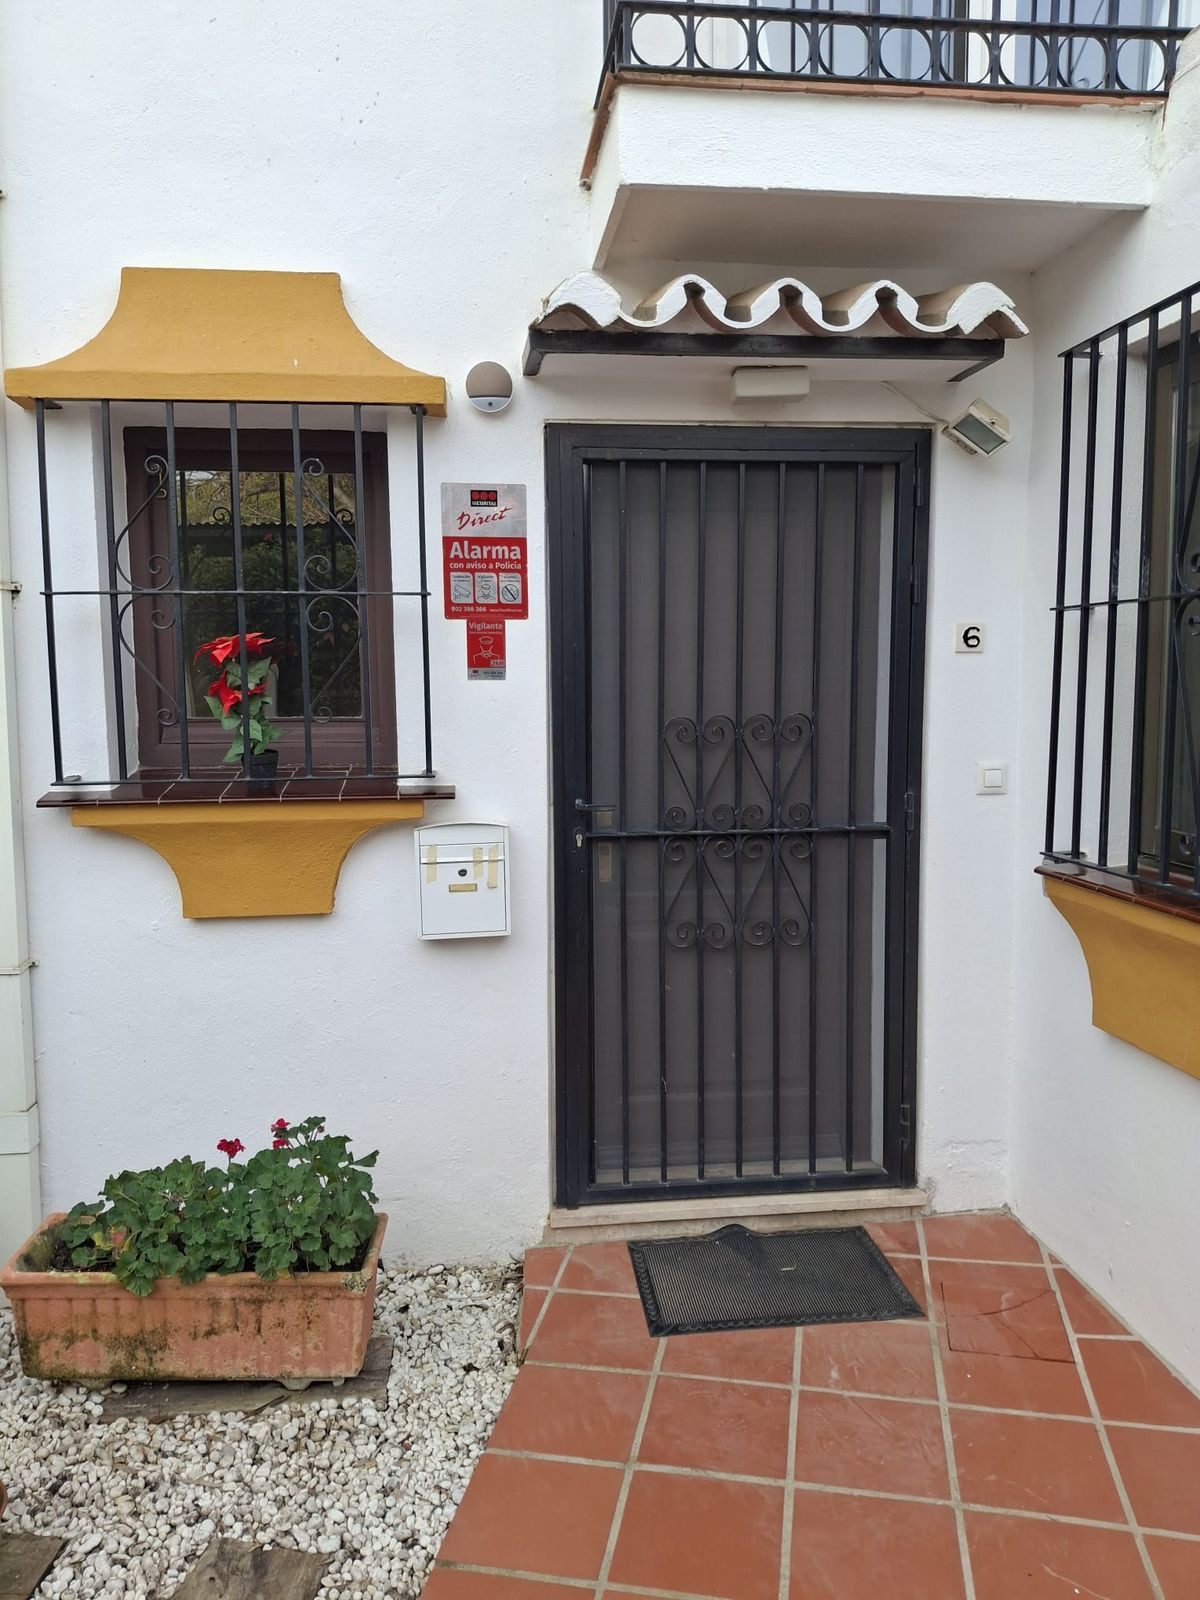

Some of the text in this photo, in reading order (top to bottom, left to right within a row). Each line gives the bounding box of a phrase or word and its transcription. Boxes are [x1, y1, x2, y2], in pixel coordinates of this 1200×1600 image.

[457, 507, 512, 530] Direct
[450, 541, 521, 559] Alarma
[465, 560, 487, 569] aviso
[495, 561, 521, 569] Policía
[468, 621, 503, 631] Vigilante
[962, 626, 981, 648] 6
